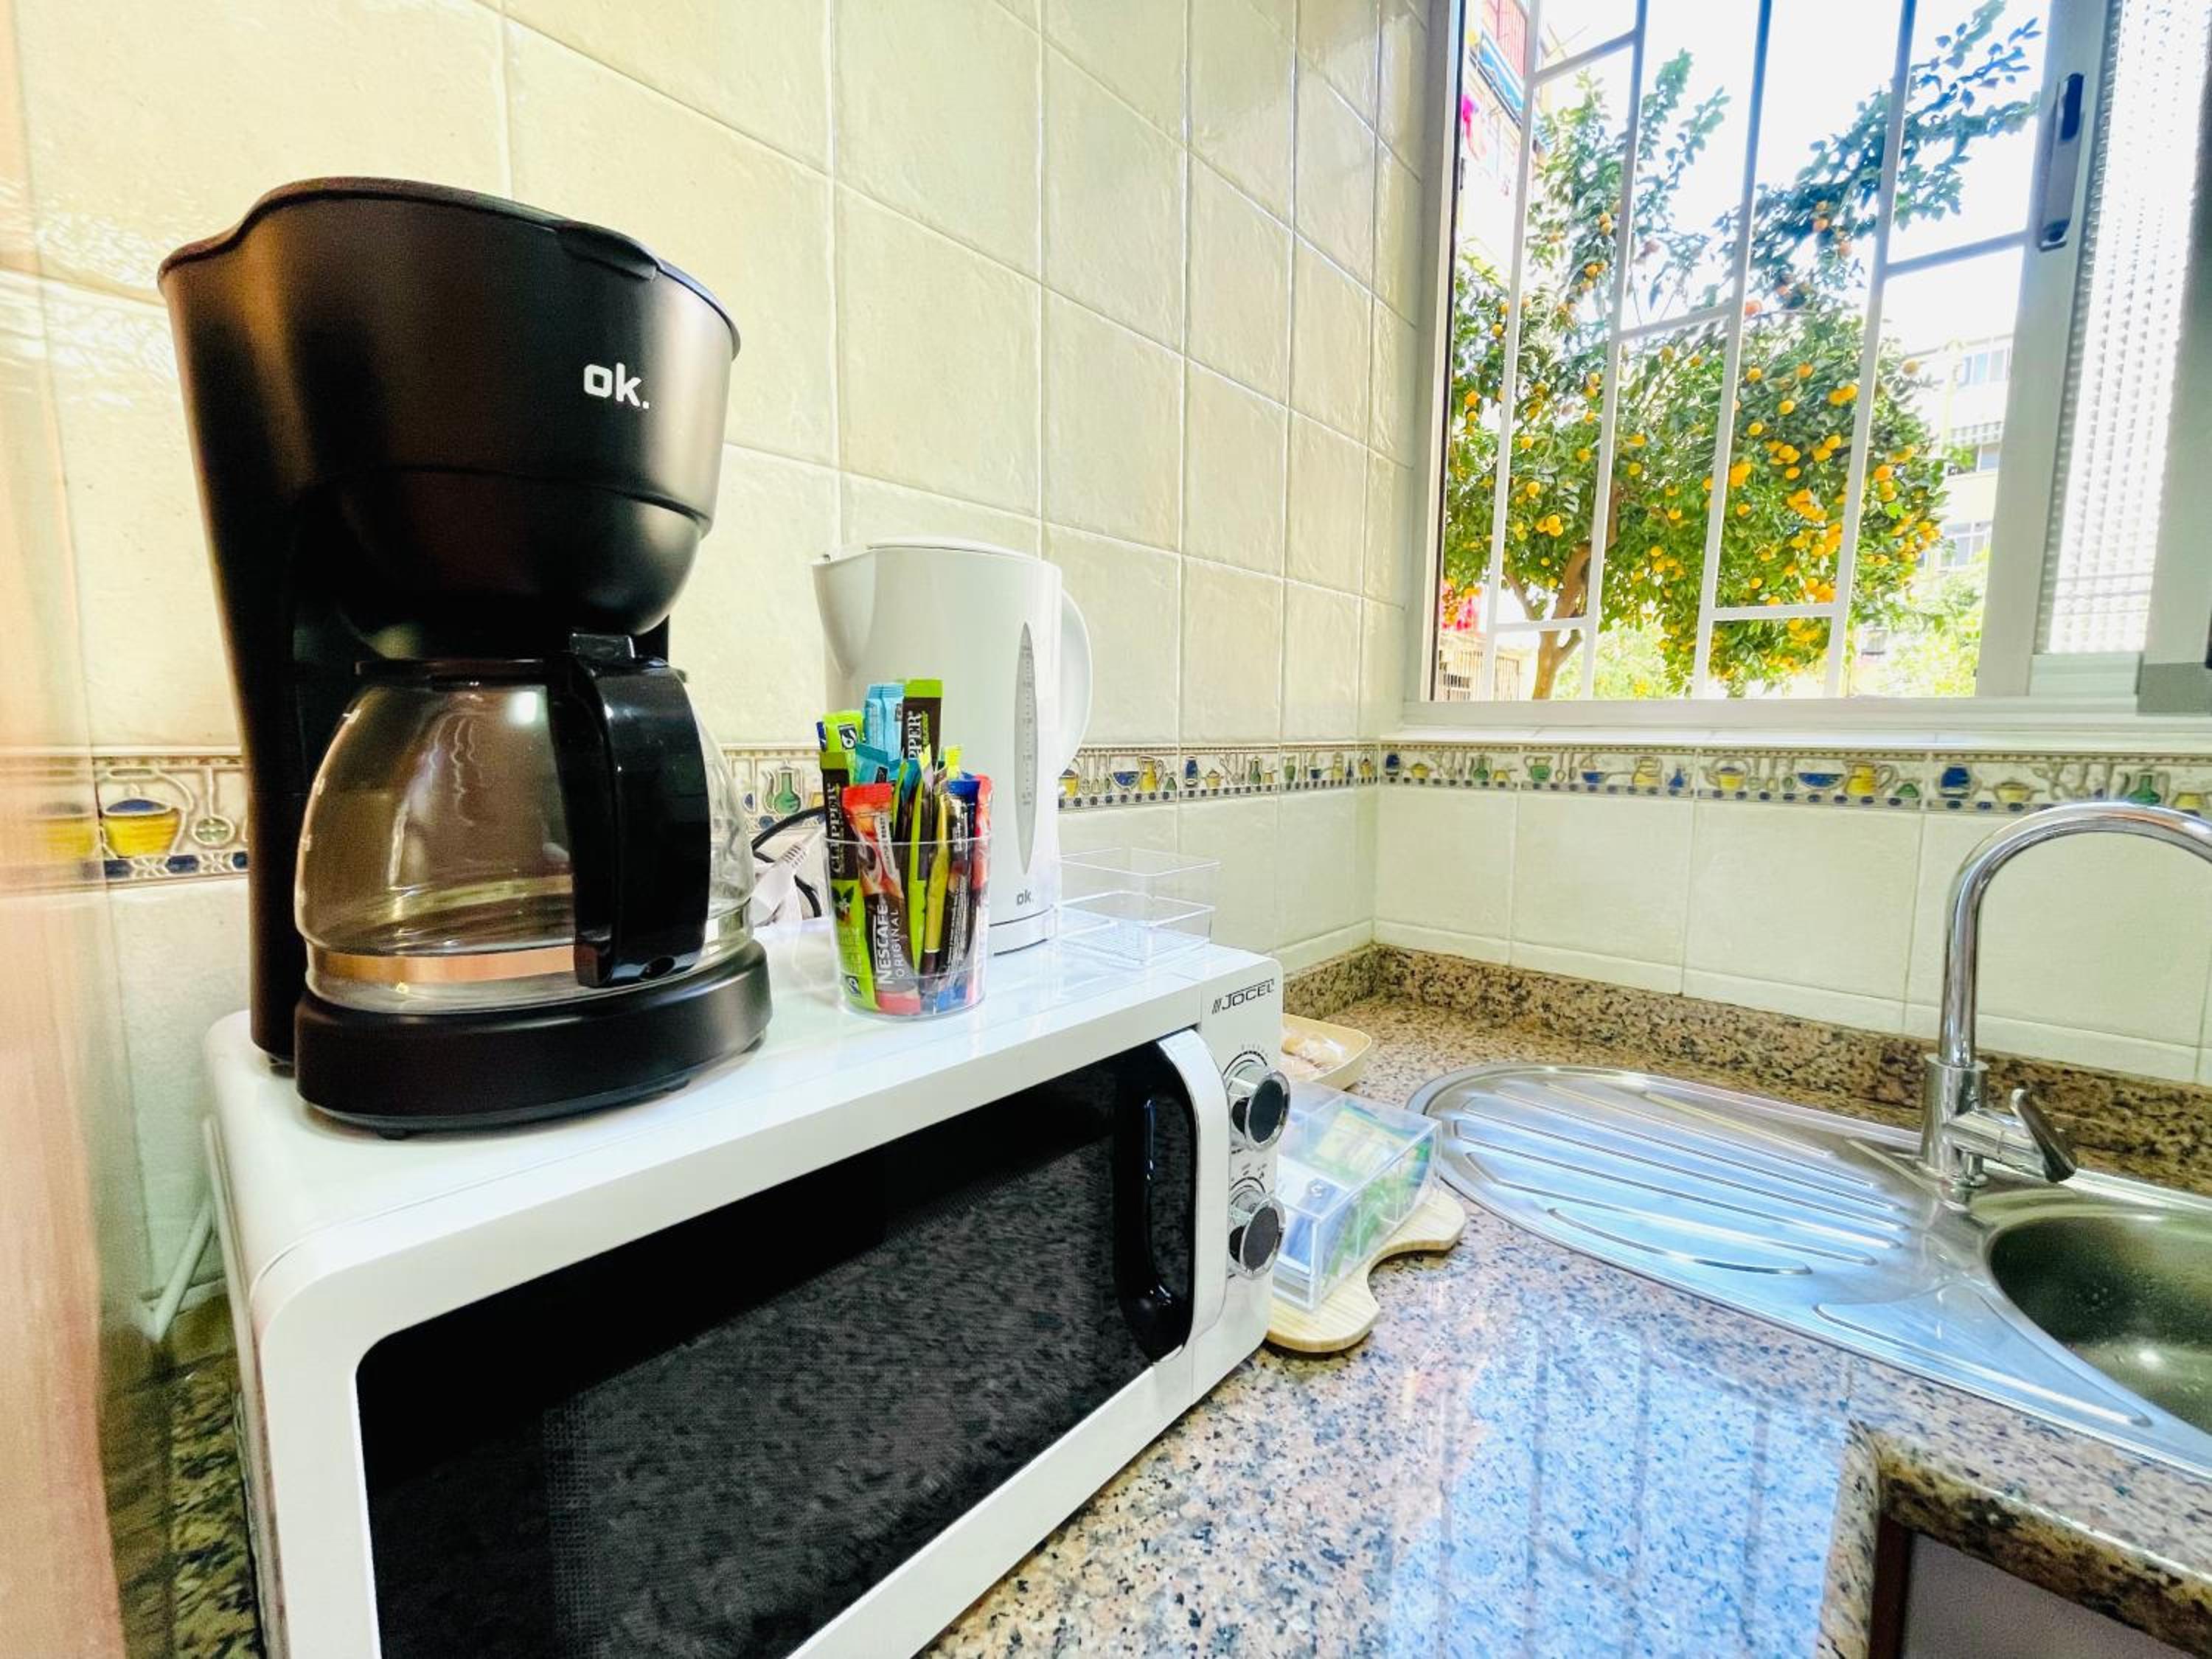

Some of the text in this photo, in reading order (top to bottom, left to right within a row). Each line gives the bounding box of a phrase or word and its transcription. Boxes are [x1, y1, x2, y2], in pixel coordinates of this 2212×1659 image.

[583, 362, 650, 409] ok.
[891, 910, 905, 978] ORIGINAL
[1222, 978, 1274, 1010] JOCEL
